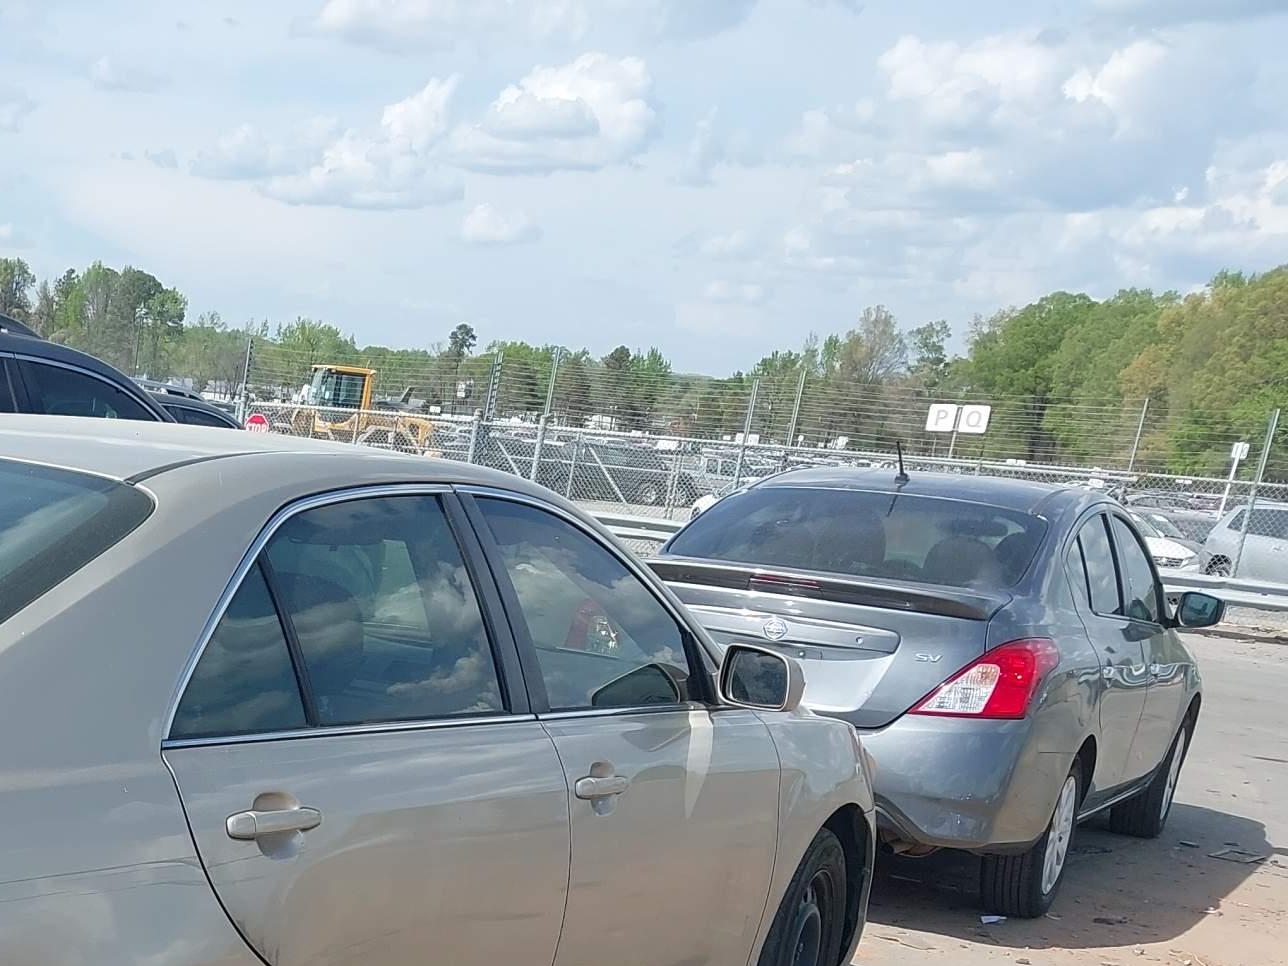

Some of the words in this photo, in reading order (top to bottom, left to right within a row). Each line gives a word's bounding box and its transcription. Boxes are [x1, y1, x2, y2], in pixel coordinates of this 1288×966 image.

[934, 409, 949, 426] P
[965, 410, 982, 428] Q
[914, 655, 944, 663] SV
